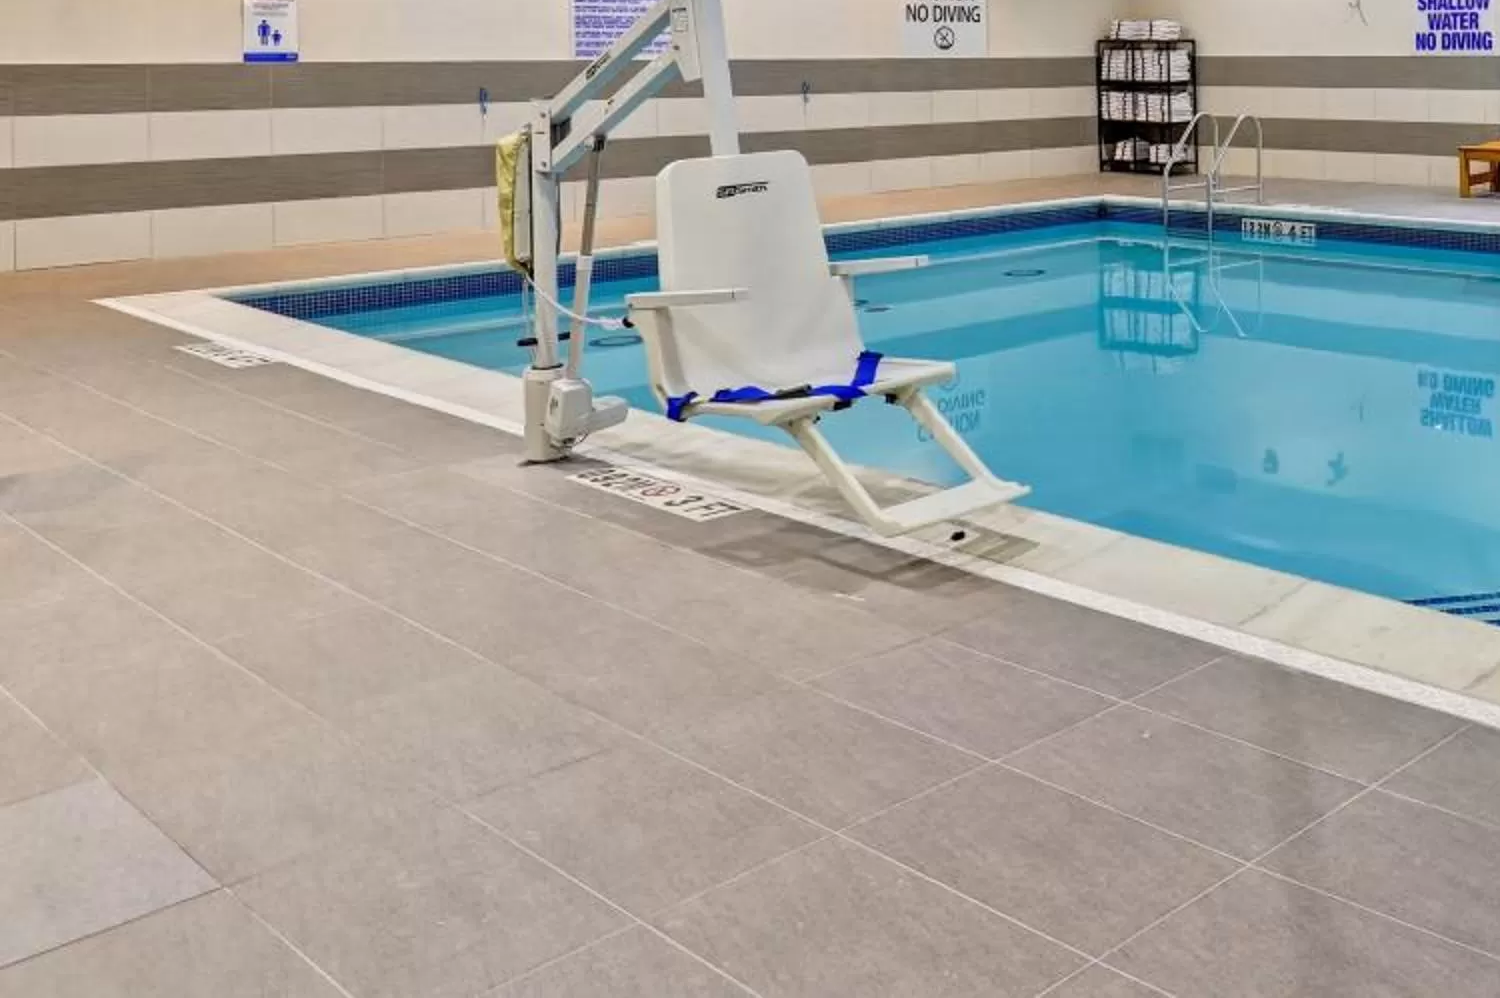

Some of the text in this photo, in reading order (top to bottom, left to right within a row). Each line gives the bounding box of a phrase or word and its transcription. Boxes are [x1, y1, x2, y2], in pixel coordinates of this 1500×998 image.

[905, 4, 981, 23] NO DIVING
[1427, 11, 1479, 31] WATER
[1415, 31, 1493, 51] NO DIVING
